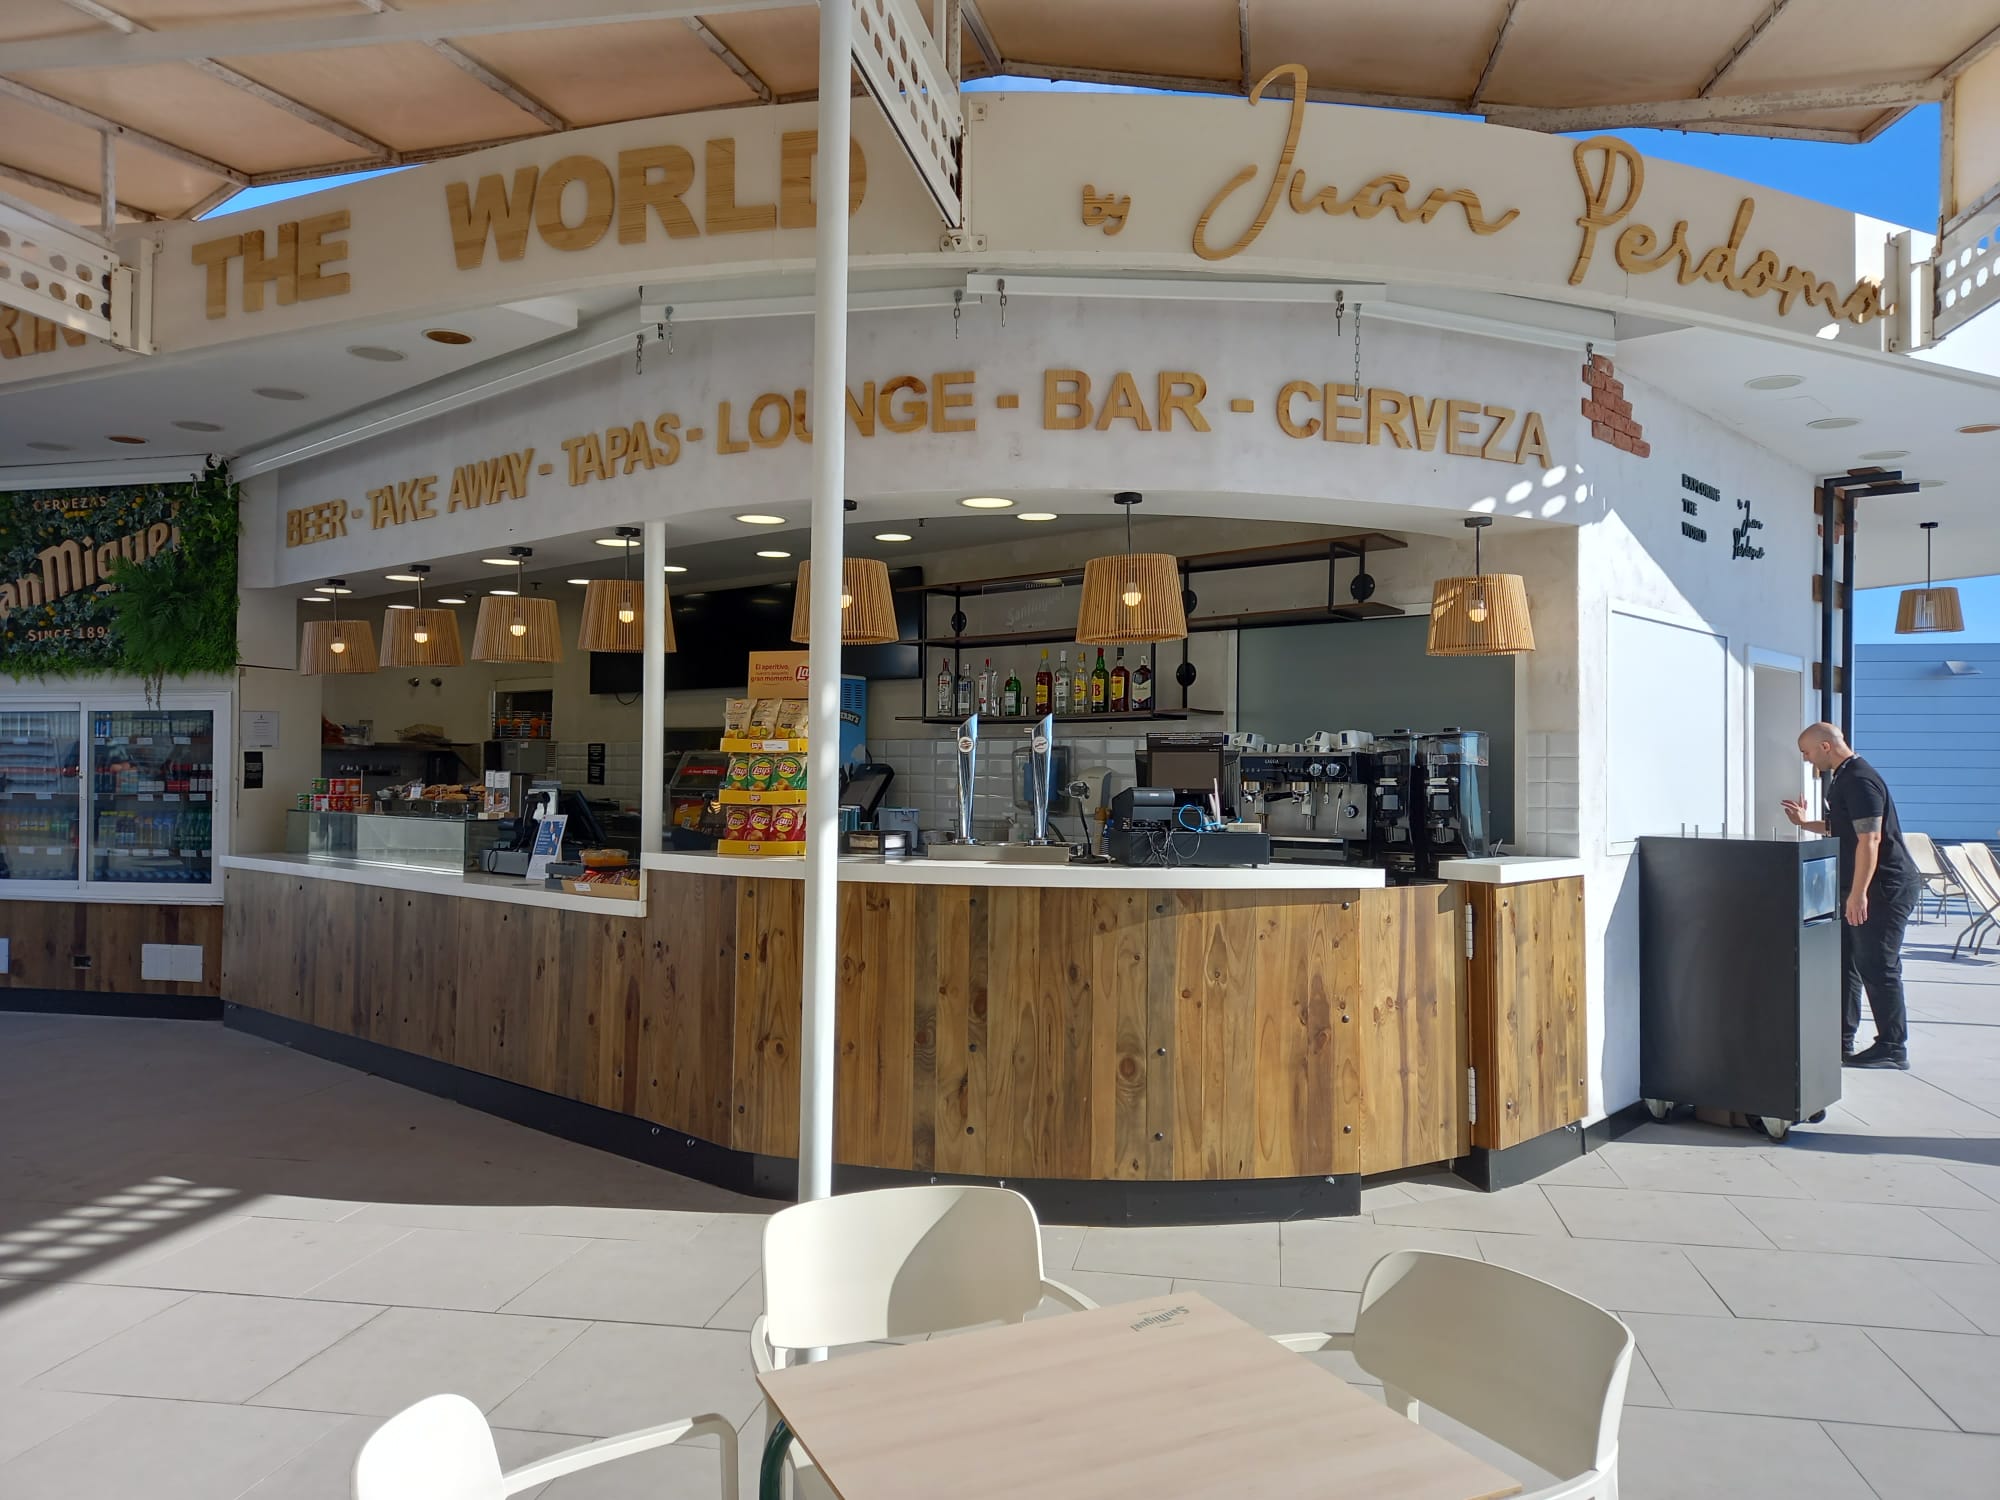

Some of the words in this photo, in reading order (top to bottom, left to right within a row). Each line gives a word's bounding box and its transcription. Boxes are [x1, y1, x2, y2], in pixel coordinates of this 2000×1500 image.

[1083, 184, 1131, 235] by
[1193, 64, 1520, 260] Juan
[1570, 136, 1895, 324] Perdomo
[192, 209, 350, 319] THE
[445, 128, 867, 271] WORLD
[286, 499, 347, 548] BEER
[367, 475, 437, 529] TAKE
[447, 448, 535, 513] AWAY
[561, 413, 680, 487] TAPAS
[1043, 369, 1211, 432] BAR
[1276, 379, 1553, 469] CERVEZA
[1681, 473, 1720, 502] EXPLORING
[33, 496, 108, 512] CERVEZAS
[1681, 498, 1697, 516] THE
[1681, 521, 1706, 543] WORLD
[78, 626, 110, 639] 189
